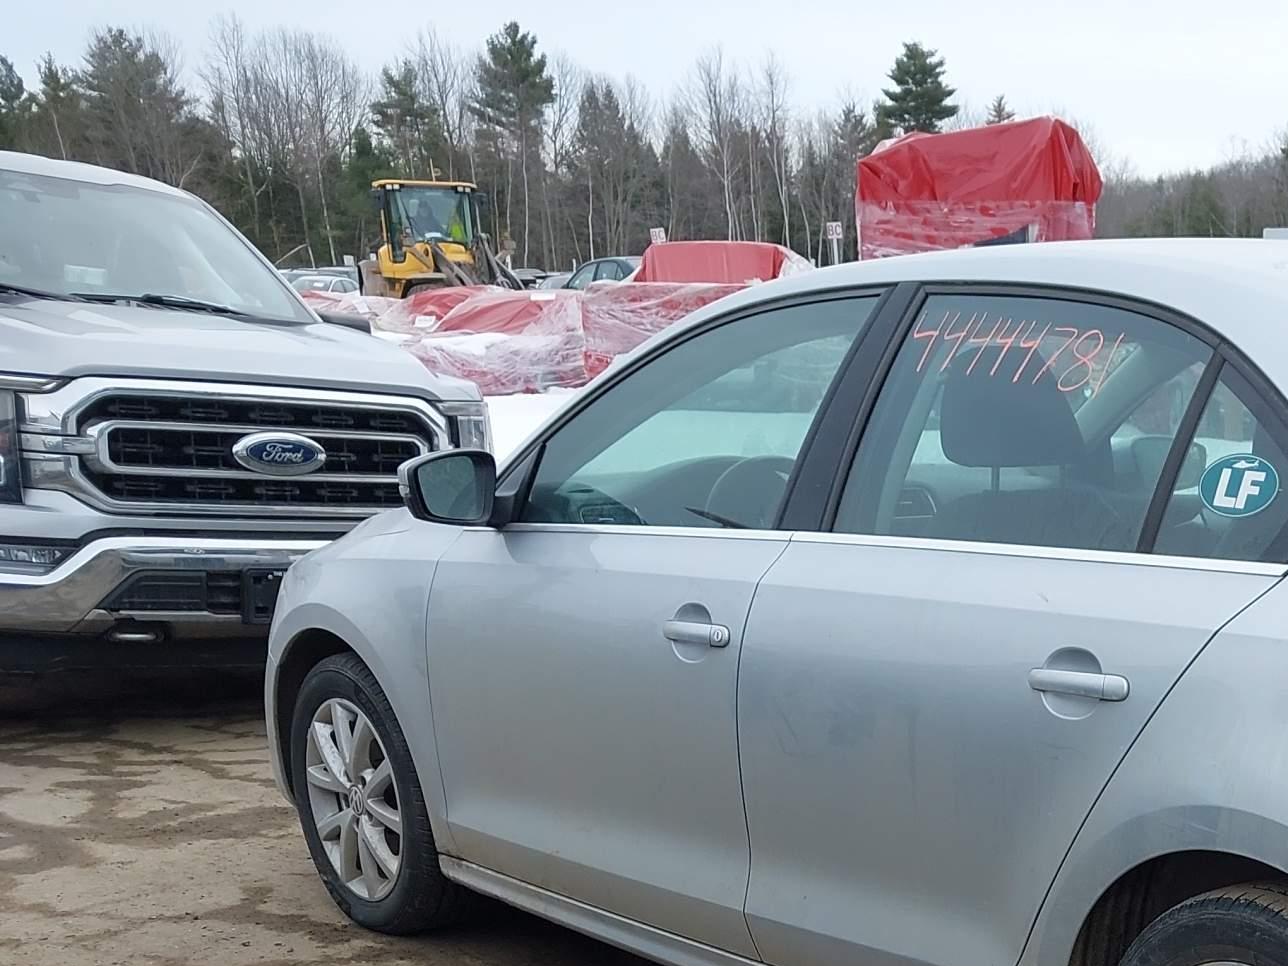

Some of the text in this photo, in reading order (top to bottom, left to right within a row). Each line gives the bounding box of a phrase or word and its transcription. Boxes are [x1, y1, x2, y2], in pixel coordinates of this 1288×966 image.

[827, 223, 842, 236] BC
[913, 310, 1125, 399] 44444781
[262, 442, 305, 462] Ford
[1212, 467, 1267, 509] LF
